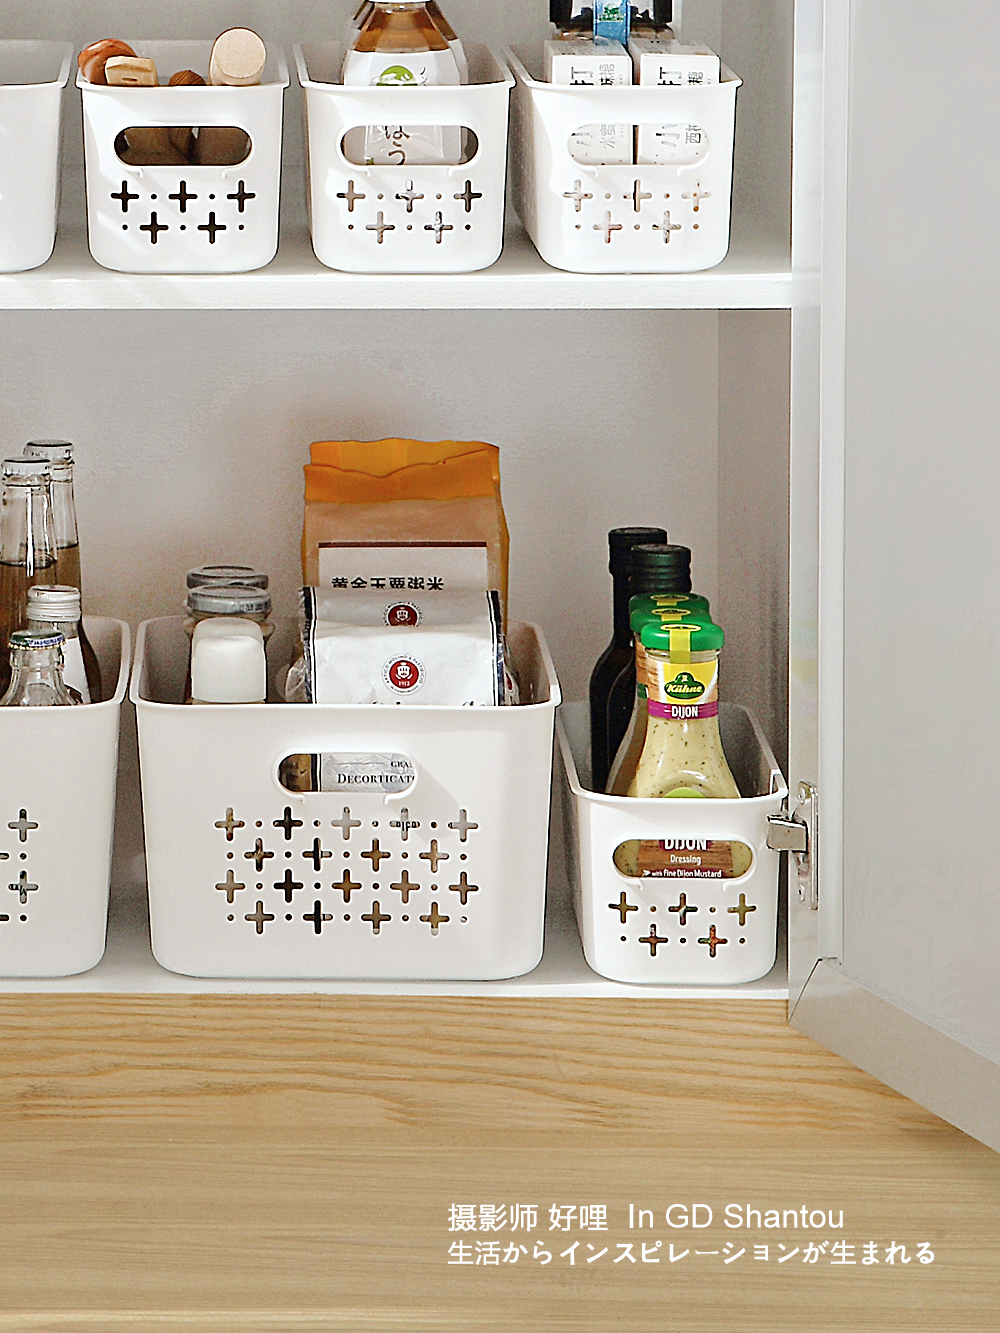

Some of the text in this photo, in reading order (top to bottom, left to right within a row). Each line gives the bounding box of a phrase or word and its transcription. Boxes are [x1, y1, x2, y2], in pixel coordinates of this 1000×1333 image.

[666, 683, 703, 693] Kühne
[671, 705, 699, 719] DIJON
[664, 838, 707, 851] DIJON
[670, 854, 702, 866] Dressing
[663, 869, 677, 877] fine
[677, 869, 694, 878] Dijon
[694, 869, 722, 878] Mustard
